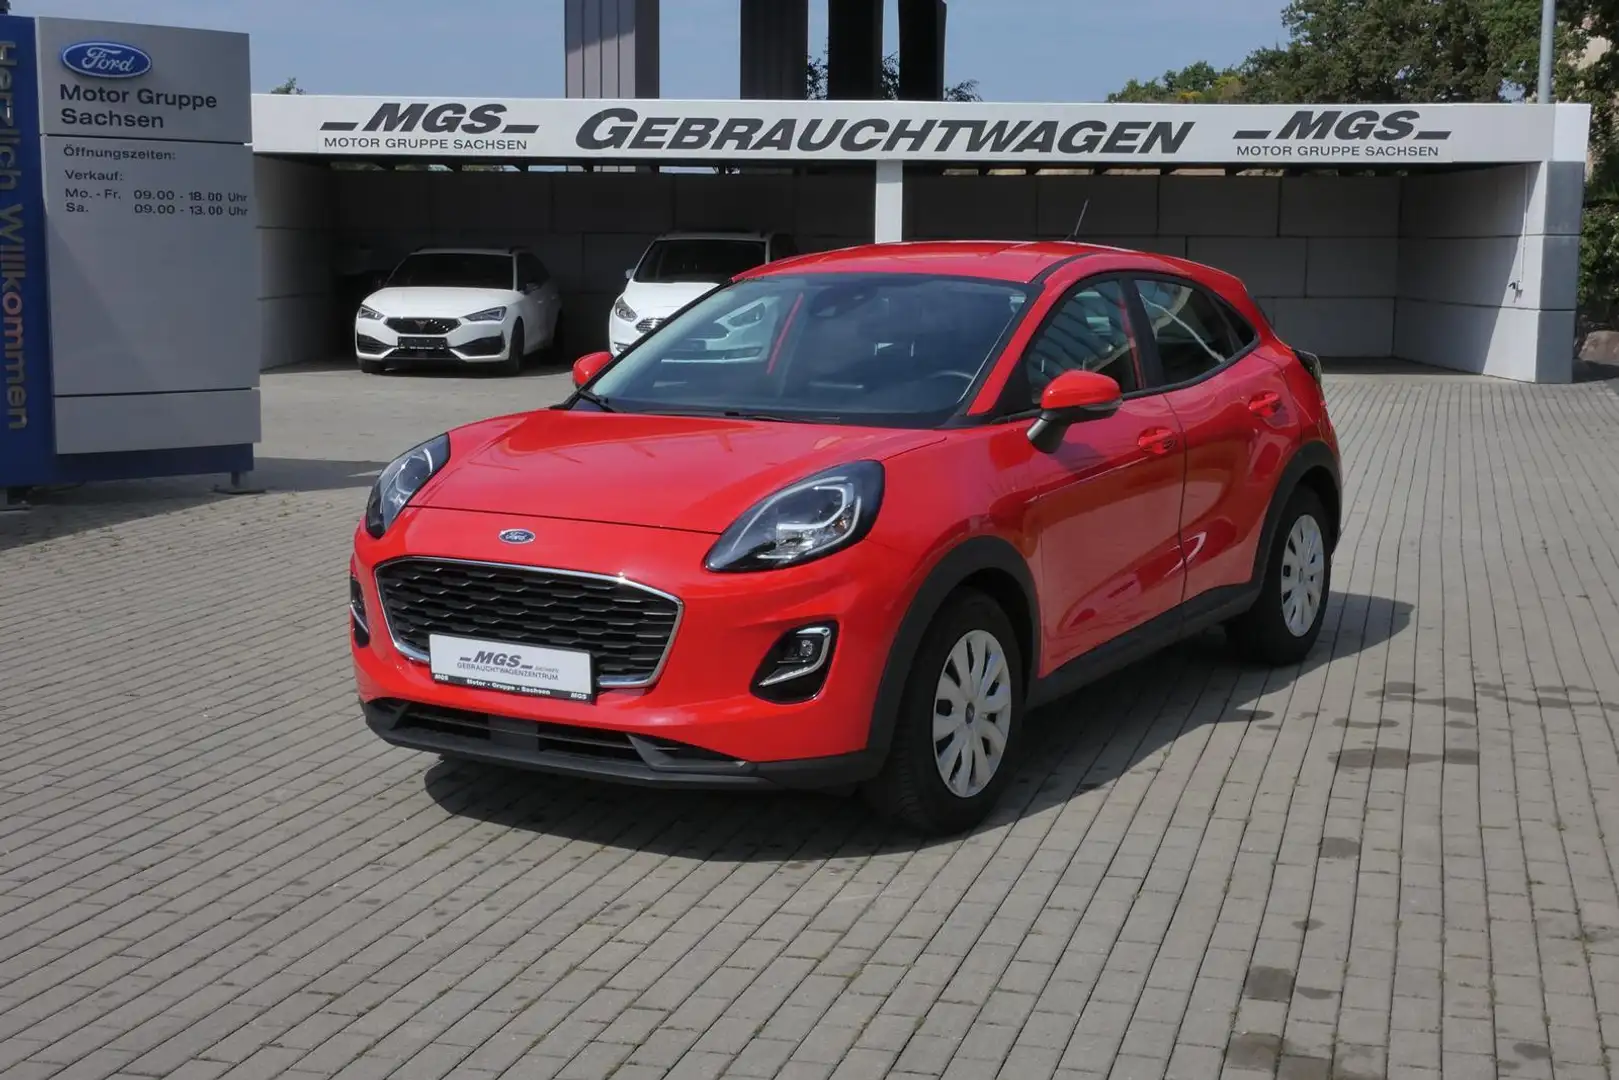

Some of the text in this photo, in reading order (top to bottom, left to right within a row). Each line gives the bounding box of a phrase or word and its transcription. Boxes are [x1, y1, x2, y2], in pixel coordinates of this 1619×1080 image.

[82, 47, 134, 72] Ford
[60, 84, 217, 110] Motor Gruppe
[61, 108, 164, 128] Sachsen
[362, 103, 508, 134] MGS
[1276, 110, 1419, 141] MGS
[575, 107, 1195, 154] GEBRAUCHTWAGEN
[63, 144, 176, 161] Öffnungszeiten:
[324, 137, 528, 151] MOTOR GRUPPE SACHSEN
[1237, 146, 1439, 157] MOTOR GRUPPE SACHSEN
[65, 170, 124, 181] Verkauf:
[65, 188, 93, 199] Mo.
[104, 189, 121, 200] Fr.
[133, 190, 175, 201] 09.00
[228, 192, 248, 202] Uhr
[66, 202, 89, 213] Sa.
[134, 204, 176, 215] 09.00
[228, 206, 248, 216] Uhr
[0, 203, 28, 430] Willkommen
[473, 650, 522, 668] MGS
[457, 662, 559, 681] GEBRAUCHTWAGENZENTRUM
